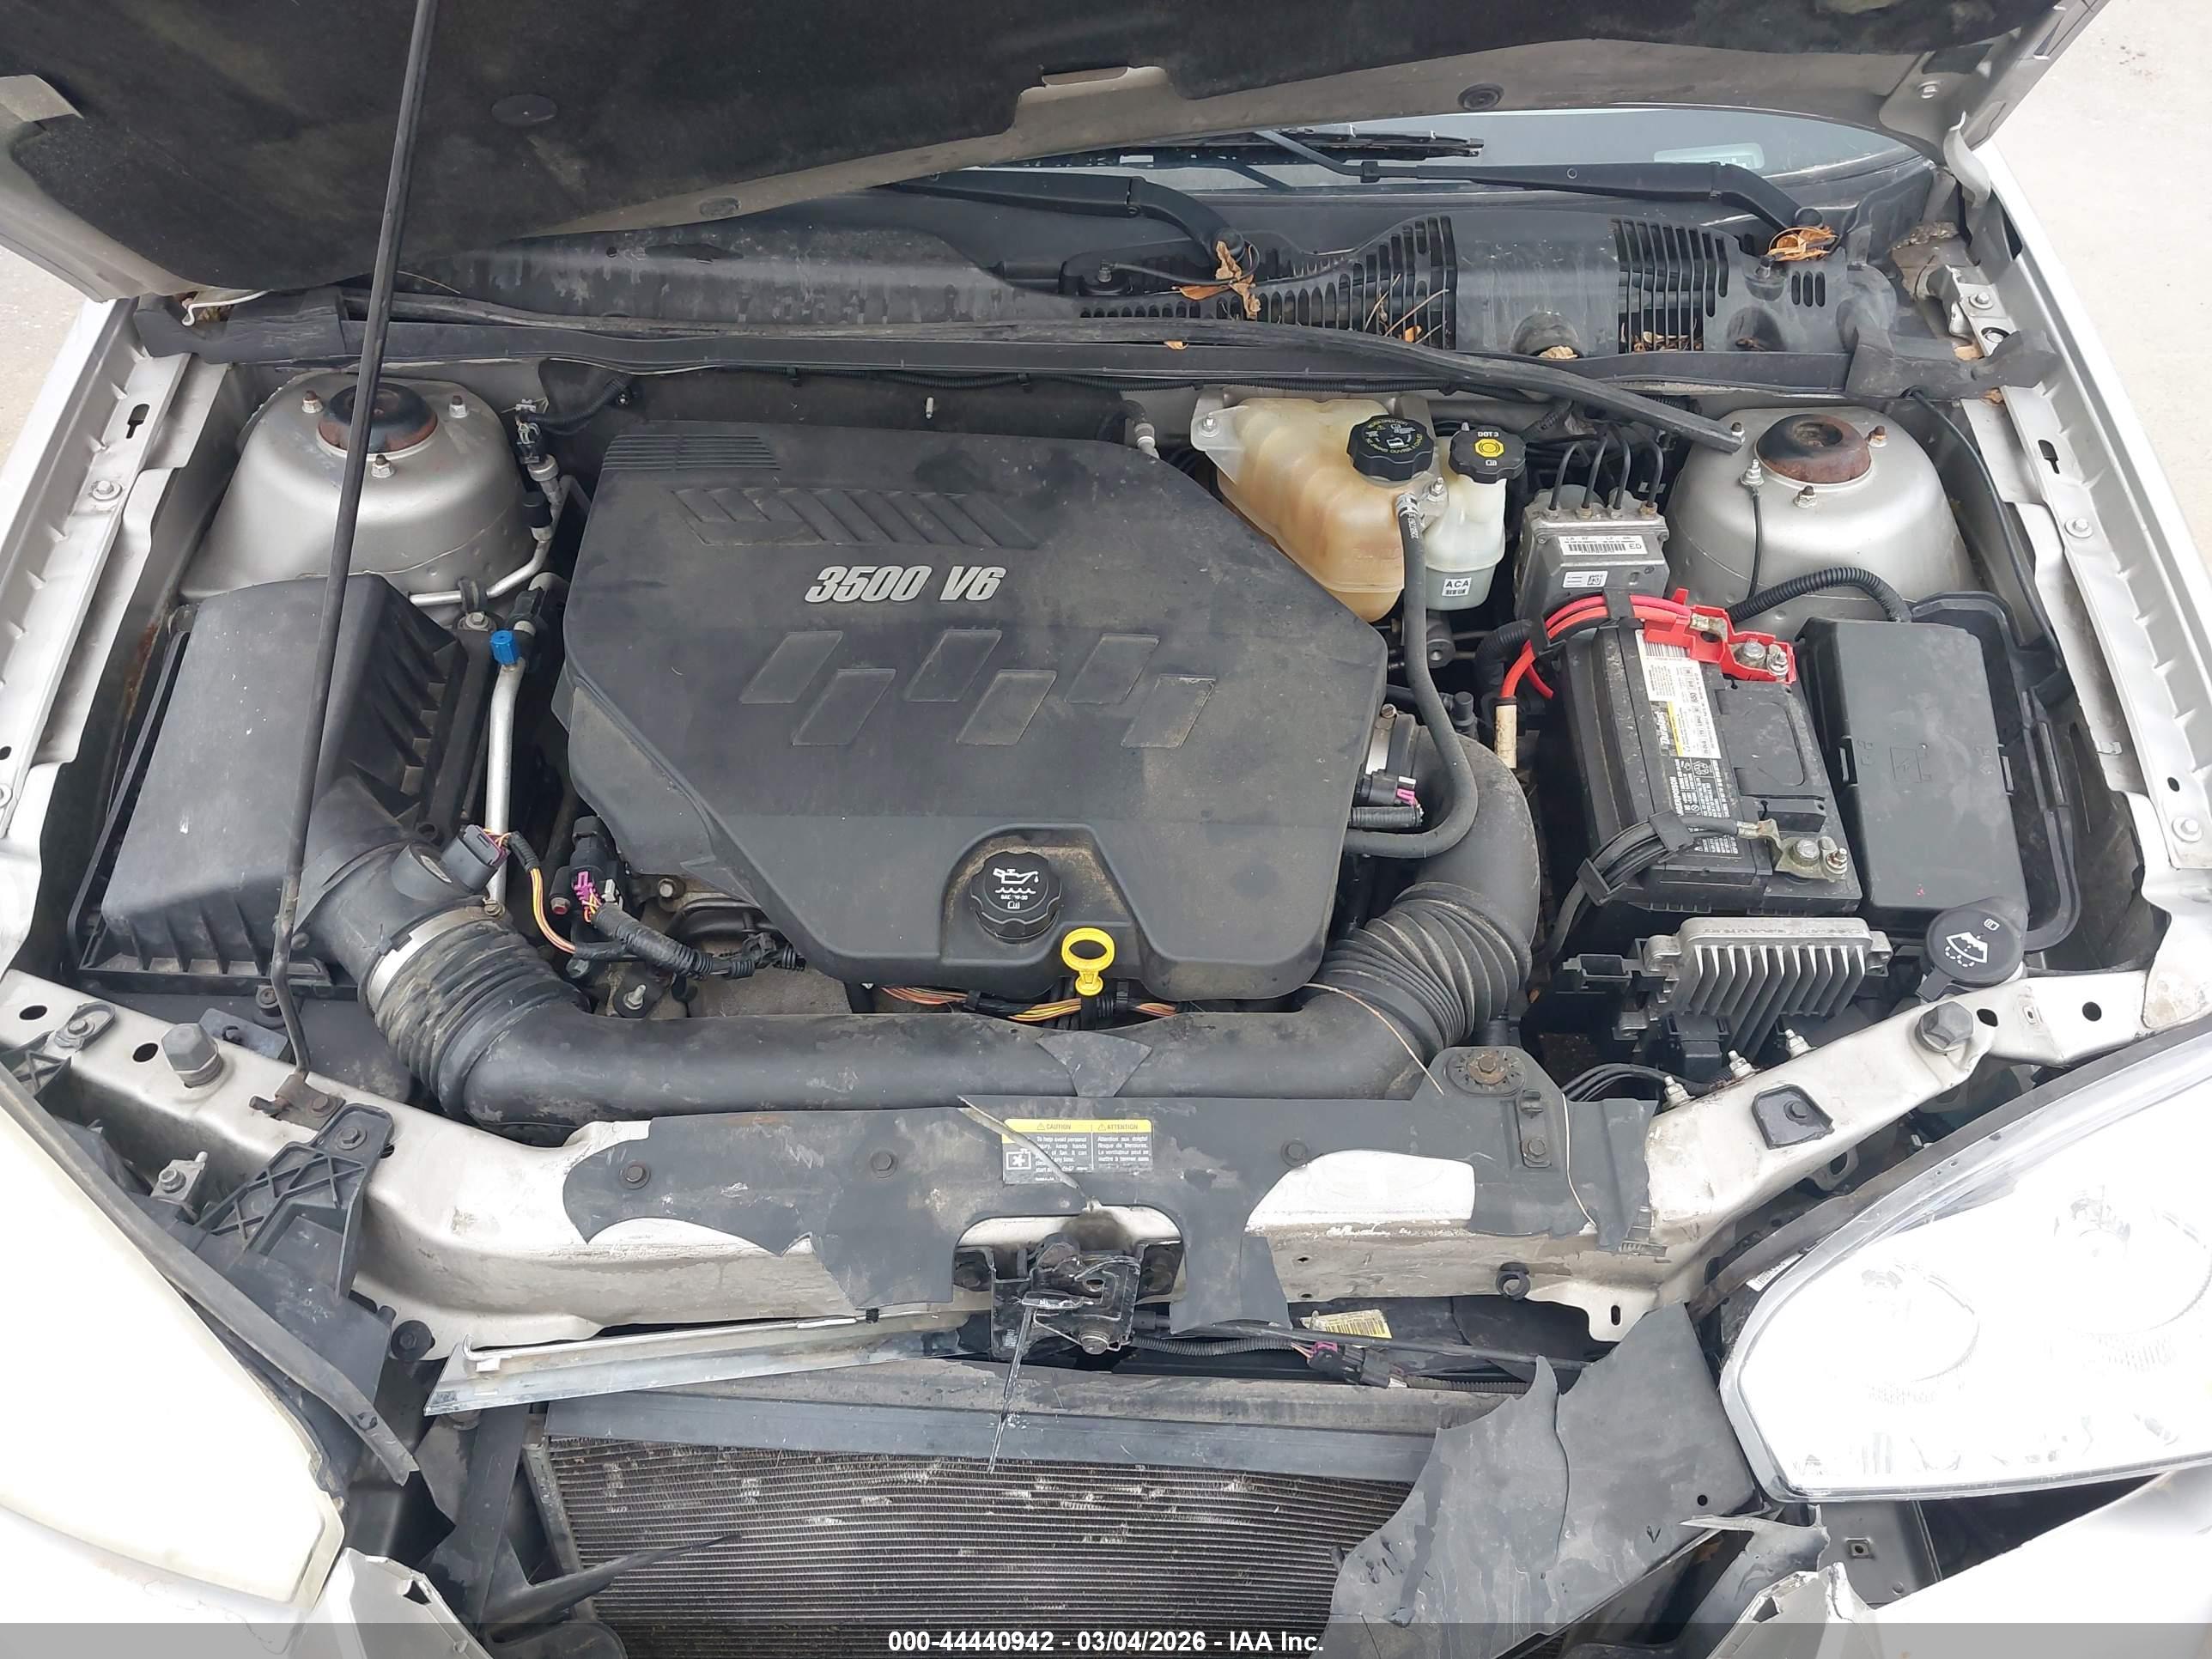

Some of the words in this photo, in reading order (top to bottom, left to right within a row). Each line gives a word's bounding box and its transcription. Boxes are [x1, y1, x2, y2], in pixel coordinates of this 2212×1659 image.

[804, 565, 933, 603] 3500
[939, 565, 1007, 602] V6
[1445, 579, 1469, 588] ACA
[1655, 711, 1670, 745] Duralast
